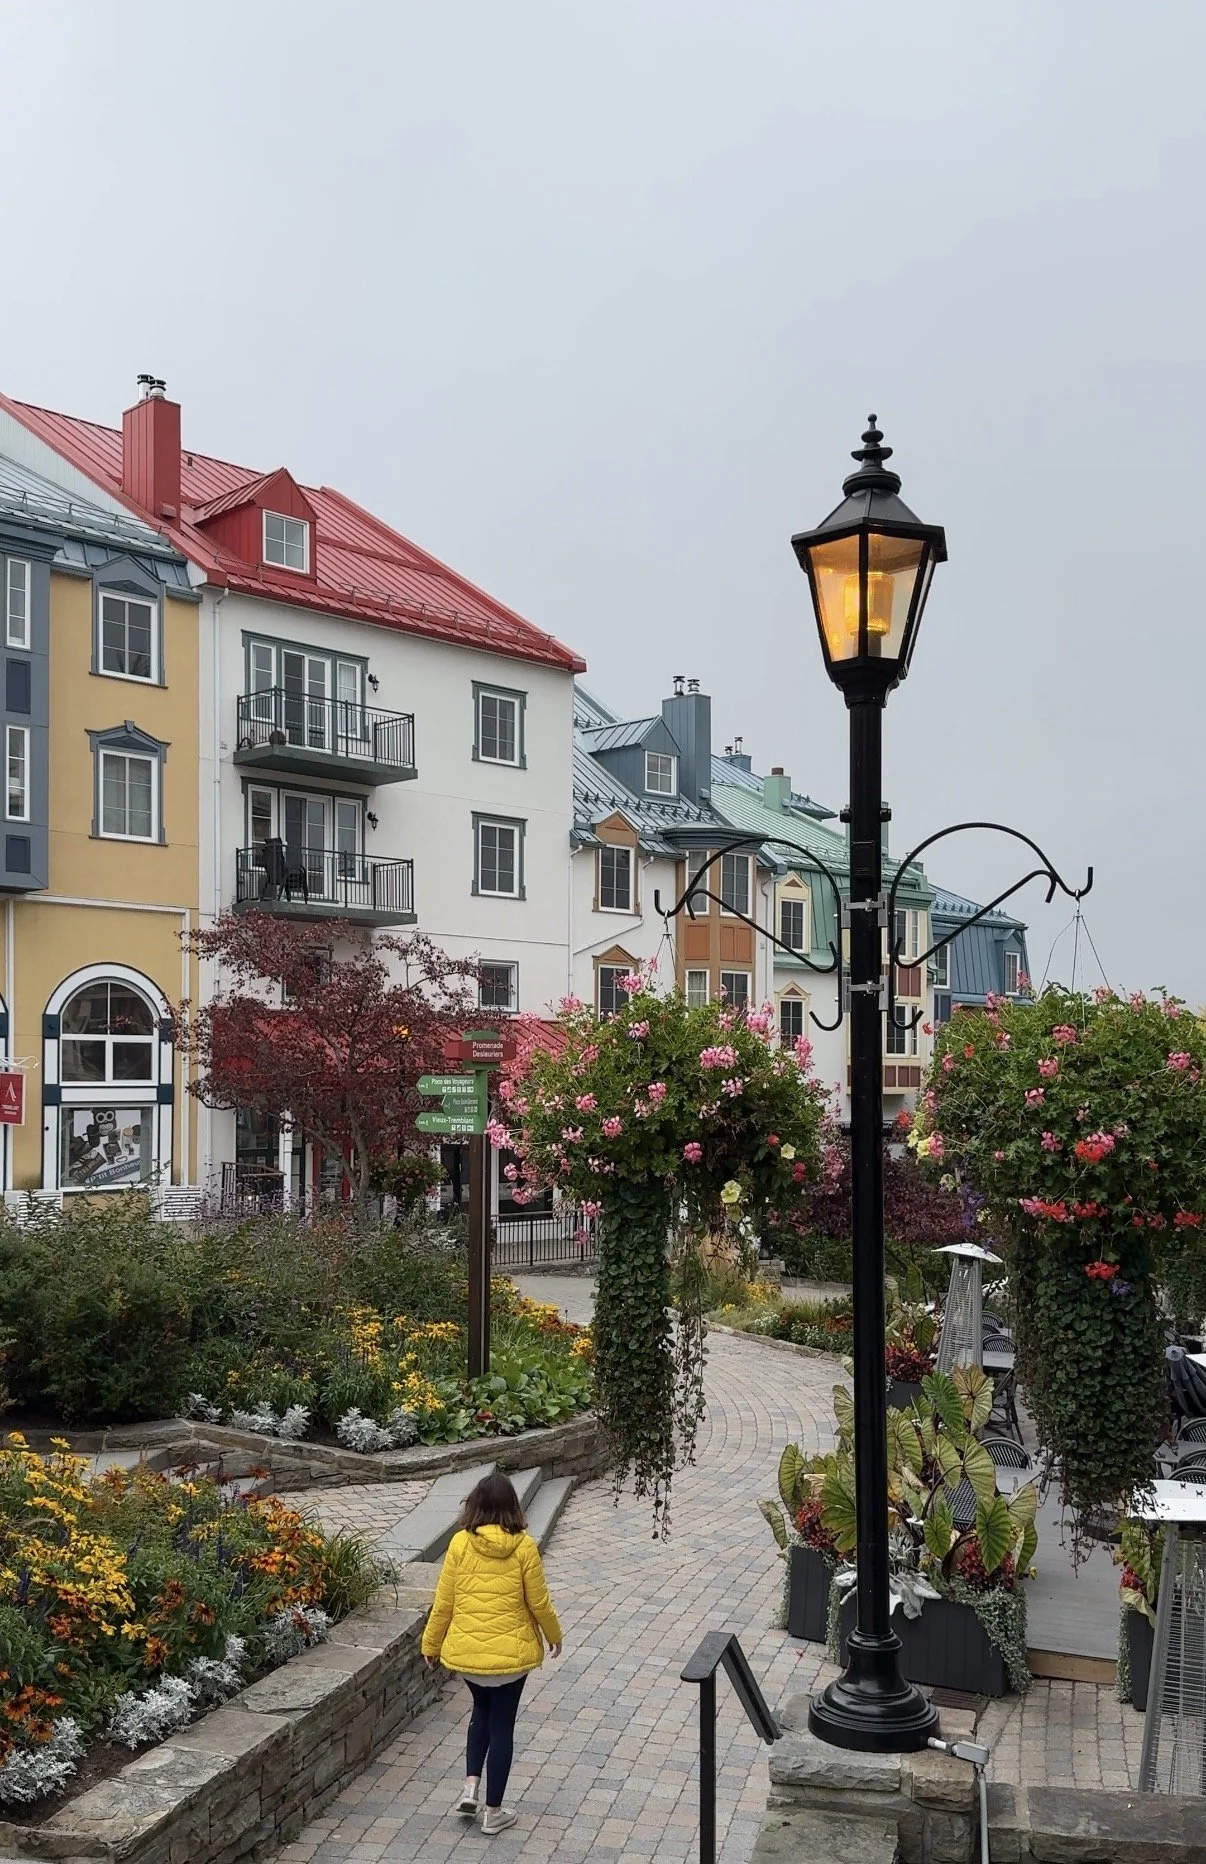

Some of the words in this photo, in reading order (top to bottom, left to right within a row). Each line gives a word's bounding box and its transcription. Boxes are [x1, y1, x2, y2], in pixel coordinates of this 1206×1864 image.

[472, 1041, 504, 1049] Promenade
[472, 1050, 504, 1058] Deslauriers
[452, 1078, 474, 1086] Voyageurs
[432, 1116, 474, 1124] Vieux-Tremblant
